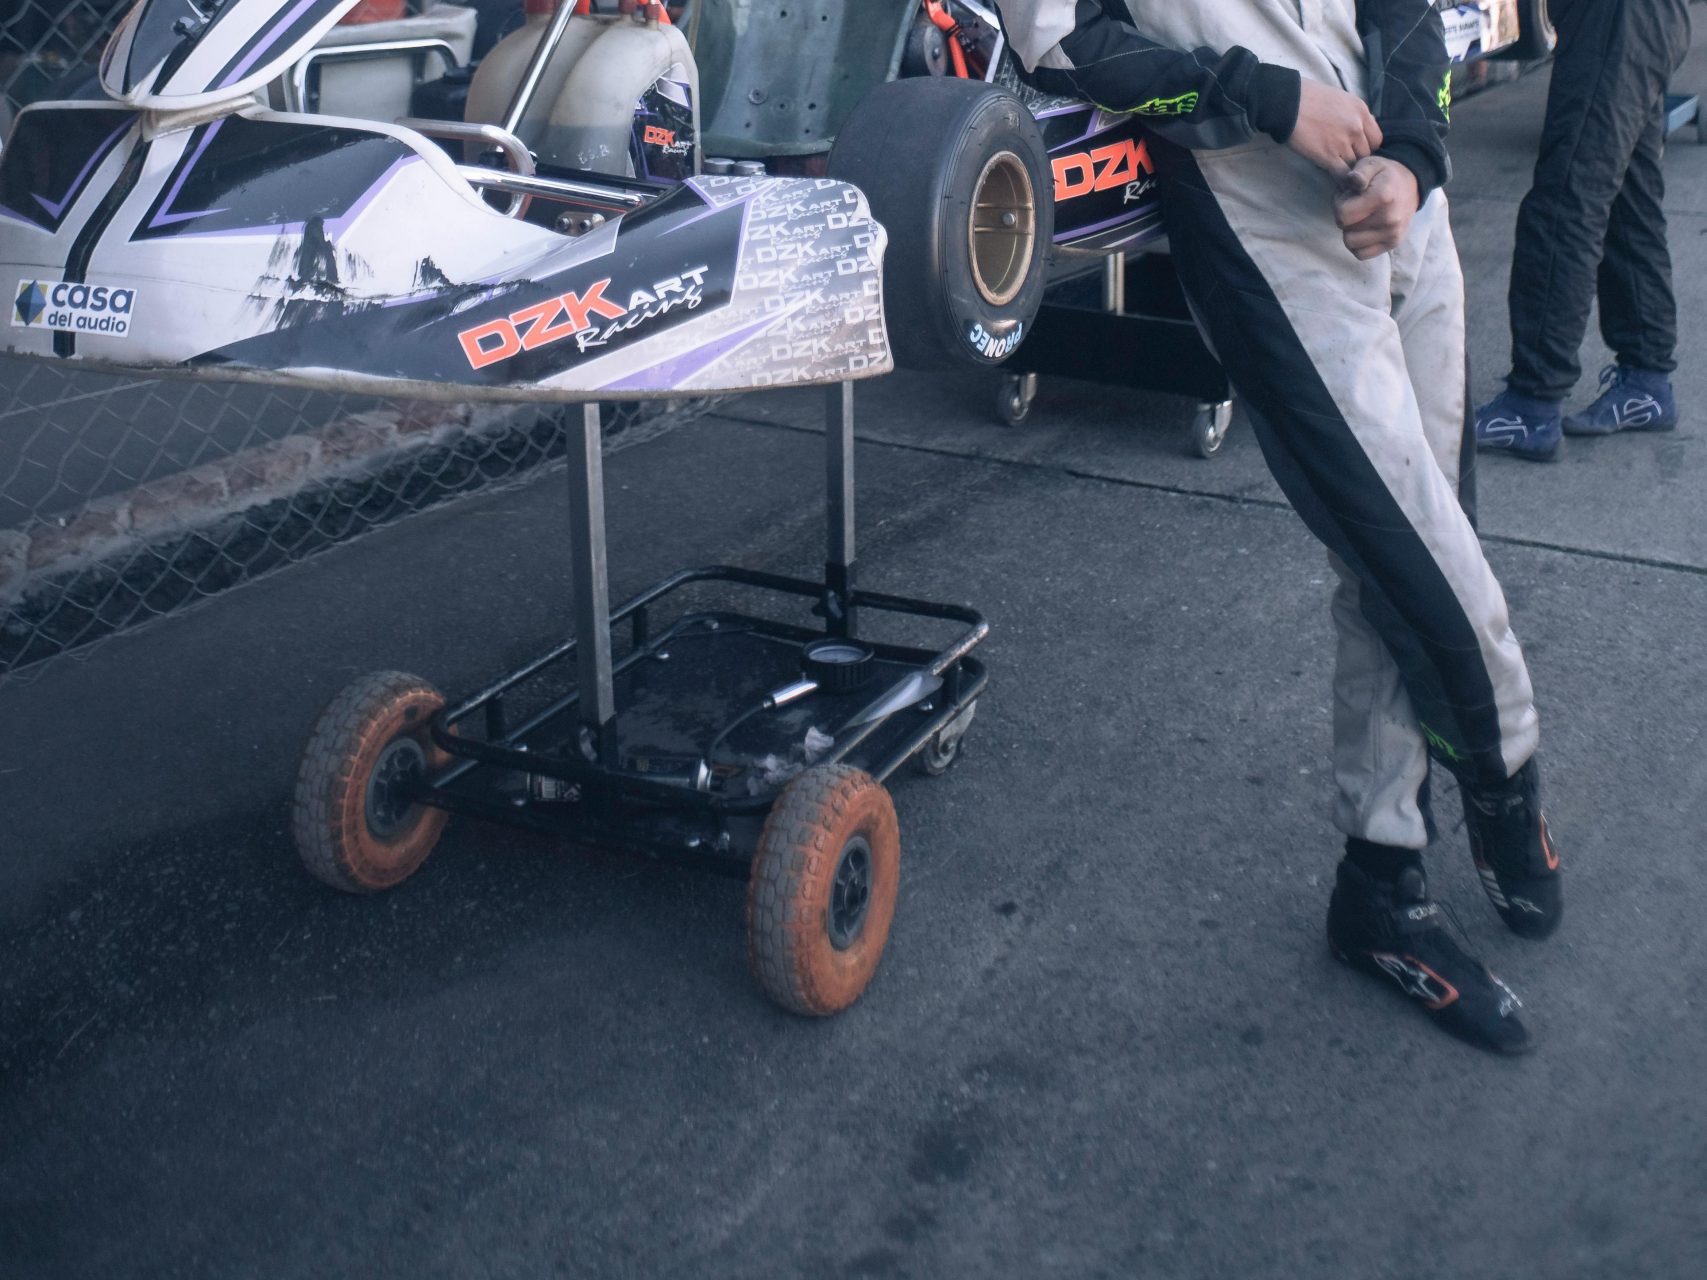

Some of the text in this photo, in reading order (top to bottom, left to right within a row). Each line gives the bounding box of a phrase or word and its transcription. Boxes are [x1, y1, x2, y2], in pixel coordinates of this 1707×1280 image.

[51, 283, 134, 314] casa
[48, 311, 127, 333] del audio
[575, 286, 702, 353] Racing
